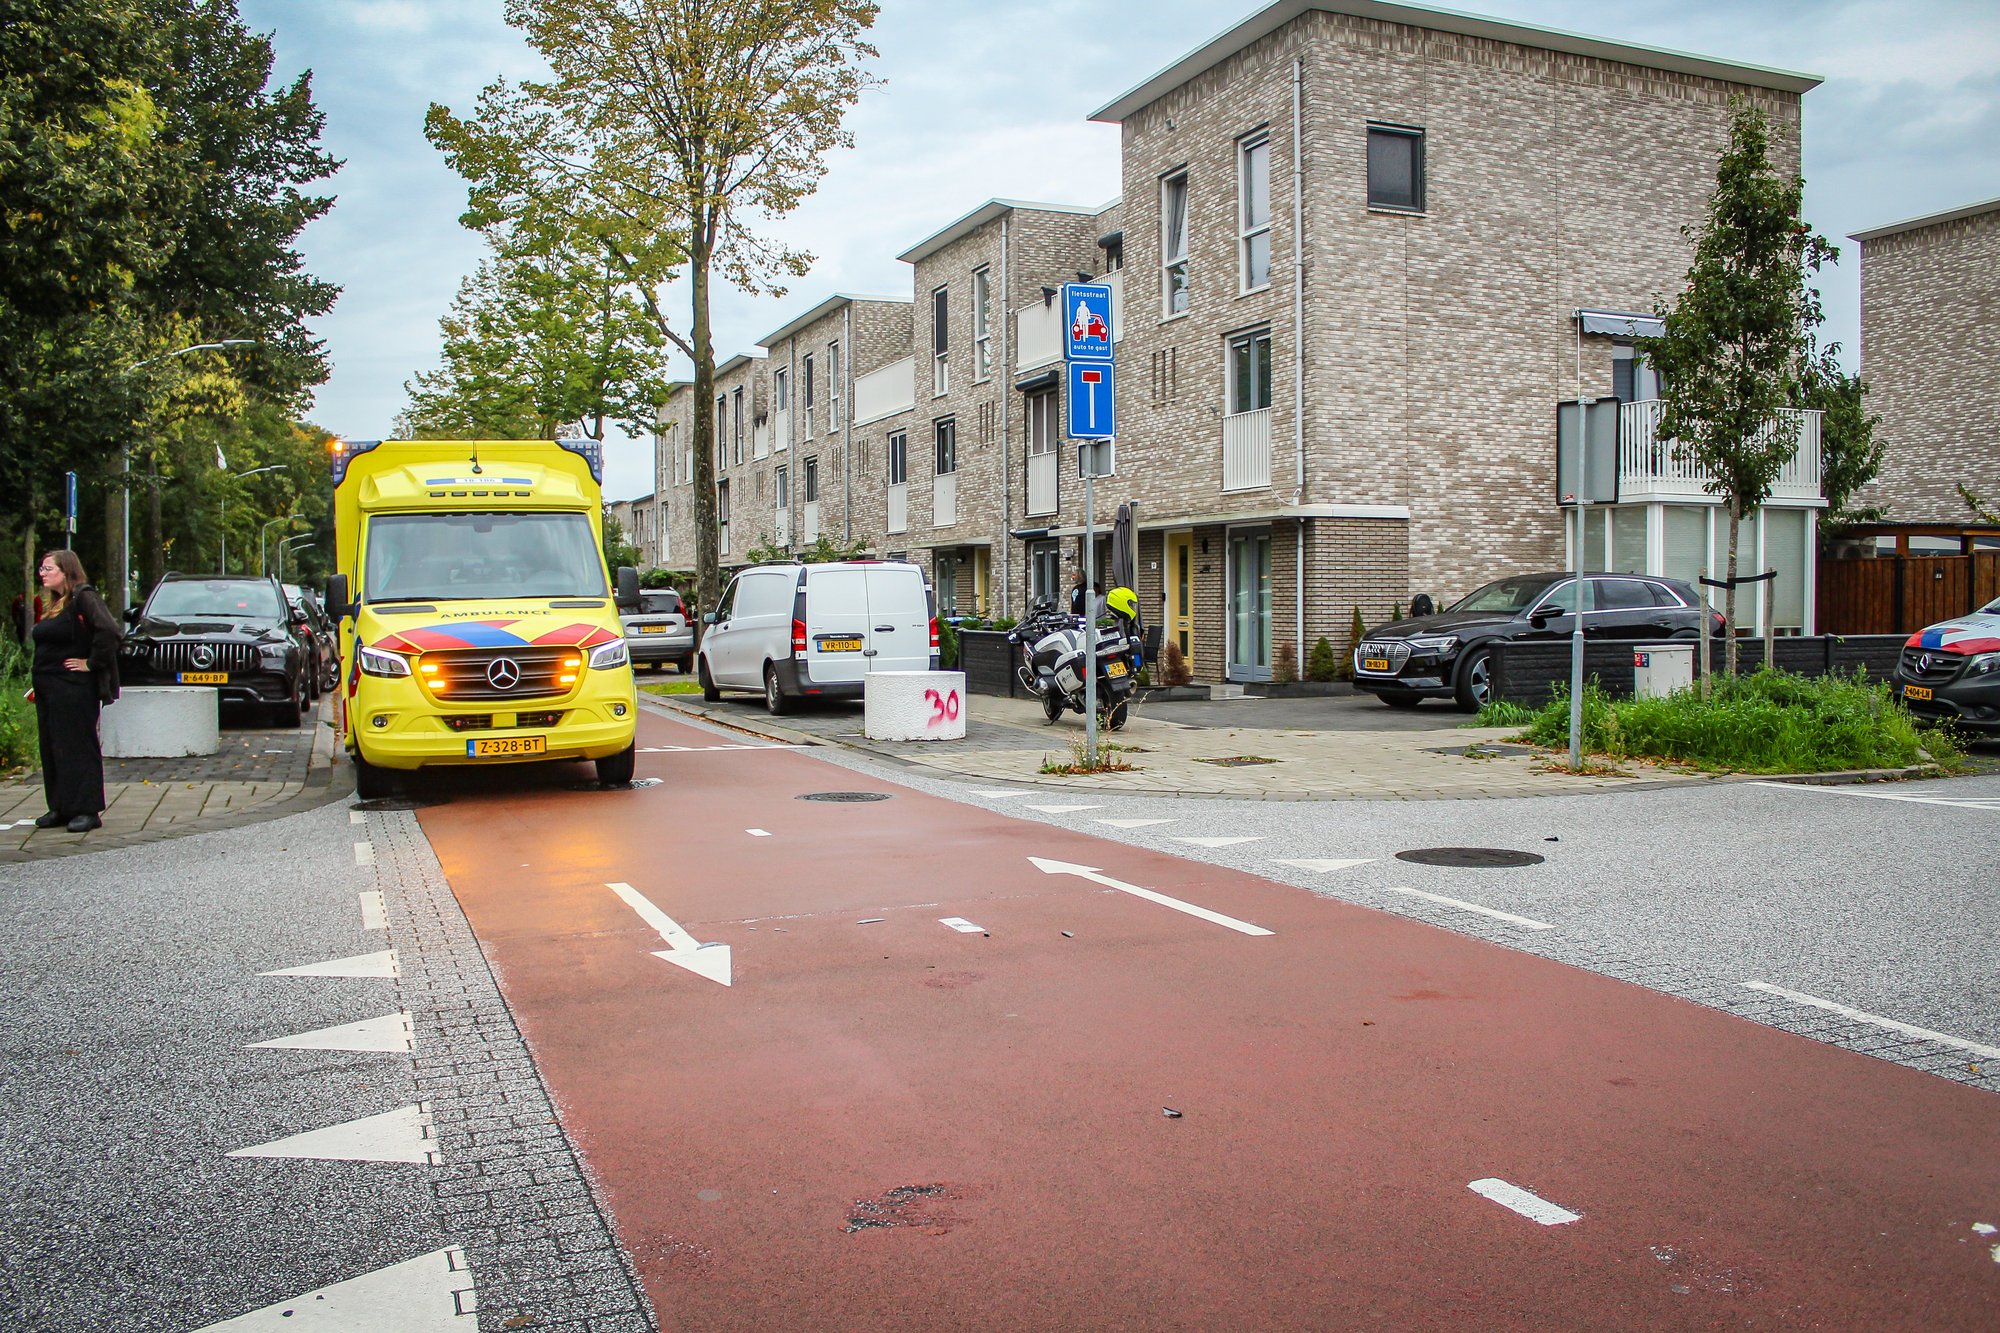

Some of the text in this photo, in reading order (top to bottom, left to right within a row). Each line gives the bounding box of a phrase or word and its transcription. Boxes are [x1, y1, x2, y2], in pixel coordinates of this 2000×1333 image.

[441, 610, 551, 619] AMBULANCE
[825, 641, 857, 649] VR-110-L
[183, 674, 225, 682] R-649-BP
[924, 688, 959, 729] 30
[481, 740, 540, 753] Z-328-BT
